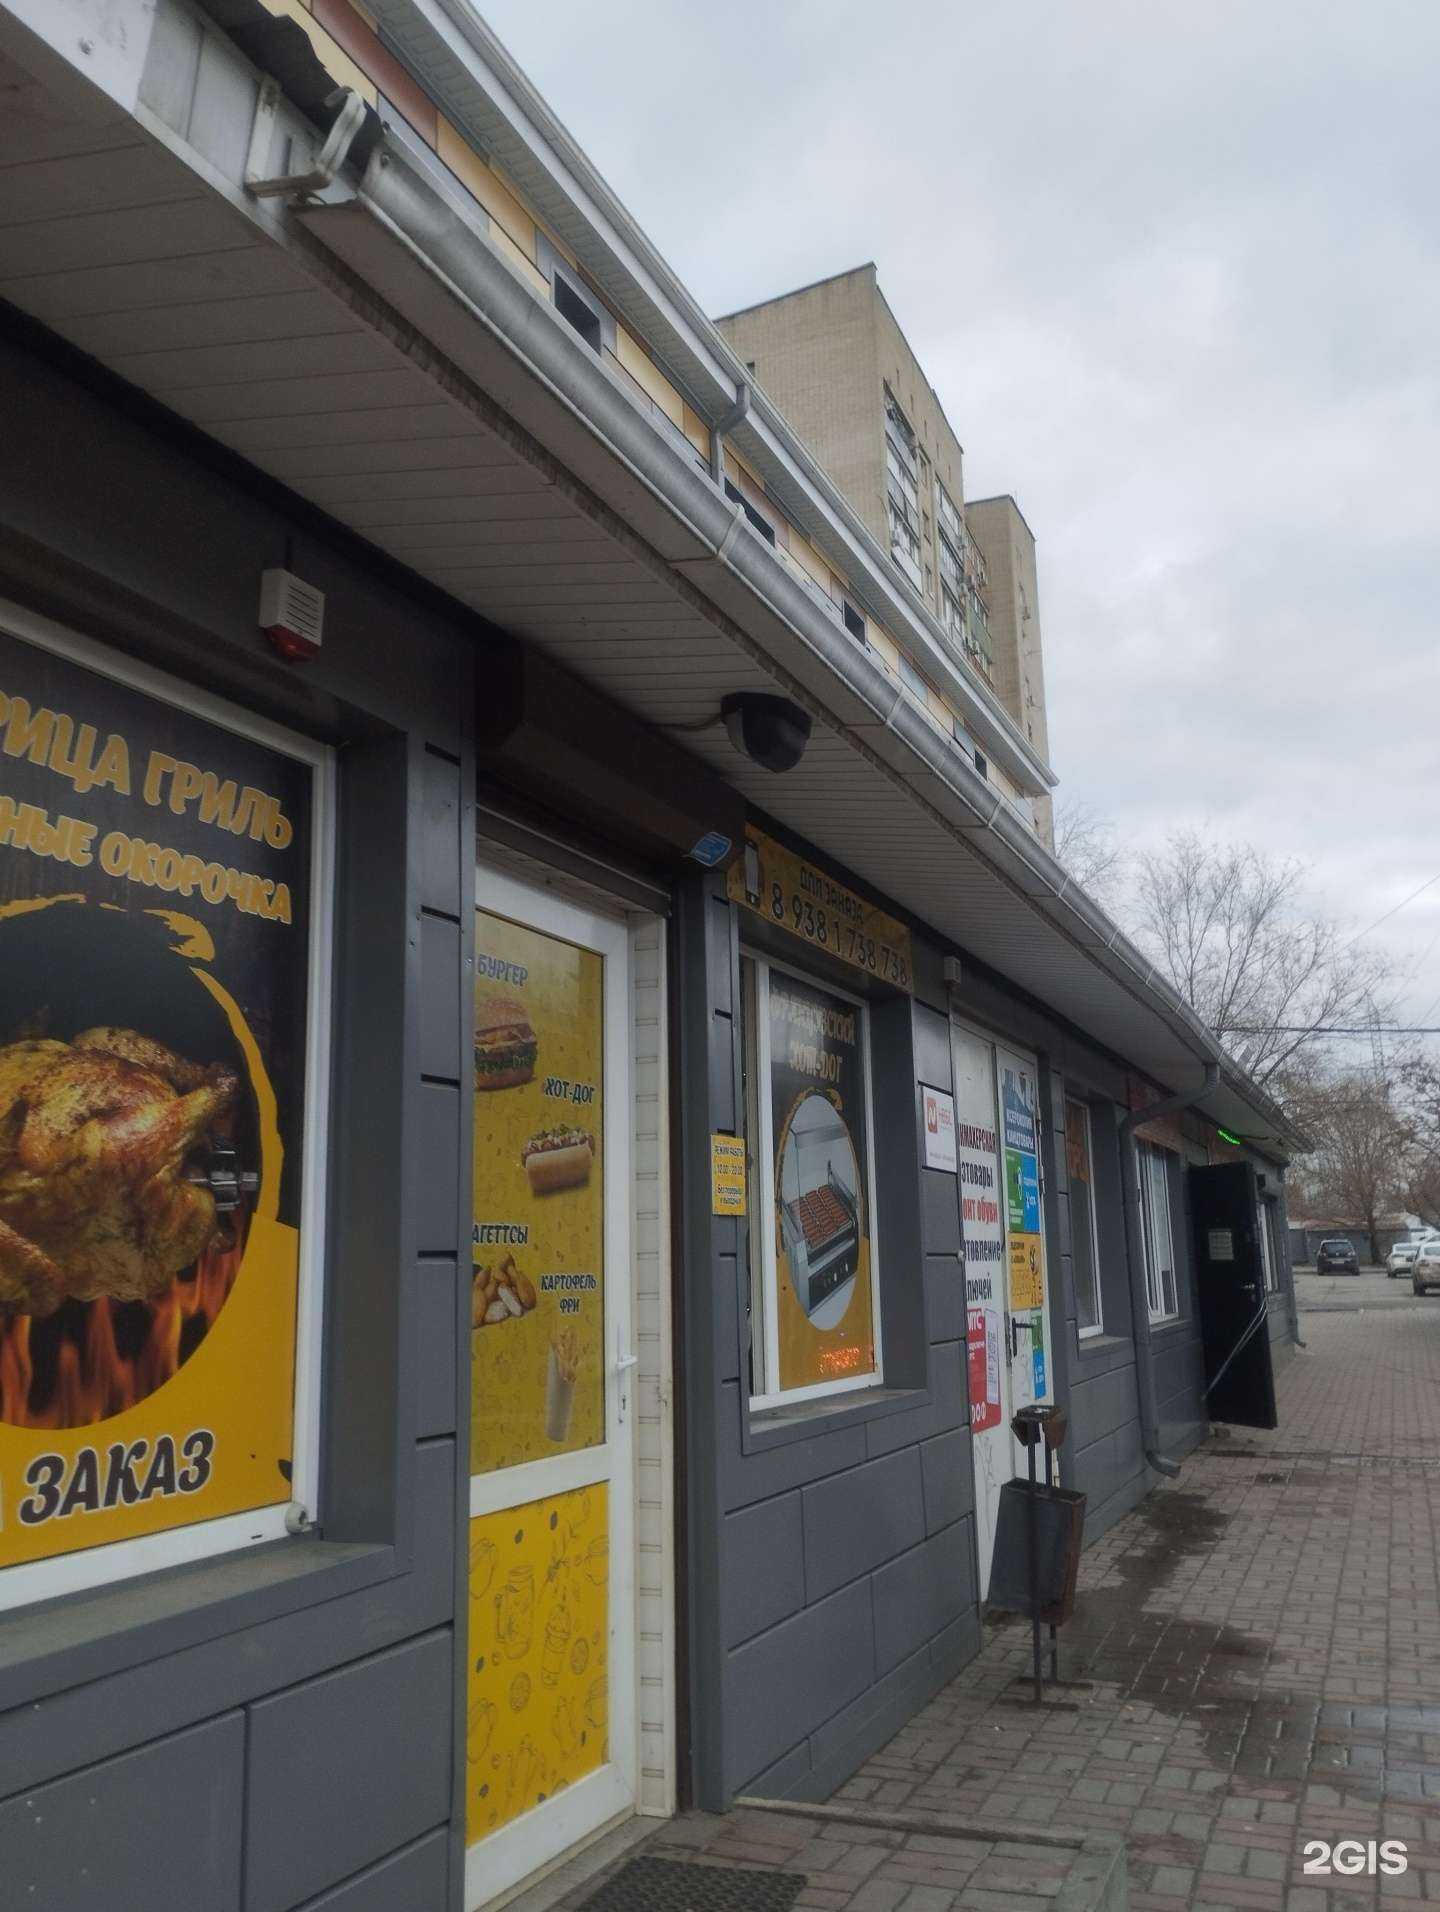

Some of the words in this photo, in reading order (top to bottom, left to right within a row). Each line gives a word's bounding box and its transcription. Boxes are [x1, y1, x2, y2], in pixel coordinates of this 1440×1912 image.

[143, 750, 293, 849] ГРИЛЬ
[100, 831, 292, 925] ОКОРОЧКА
[771, 882, 785, 920] 8
[791, 893, 828, 946] 938
[477, 954, 529, 987] БУРГЕР
[544, 1077, 595, 1104] ХОТ-ДОГ
[540, 1274, 597, 1291] КАРТОФЕЛЬ
[559, 1298, 580, 1314] ФРИ
[18, 1428, 216, 1526] ЗАКАЗ
